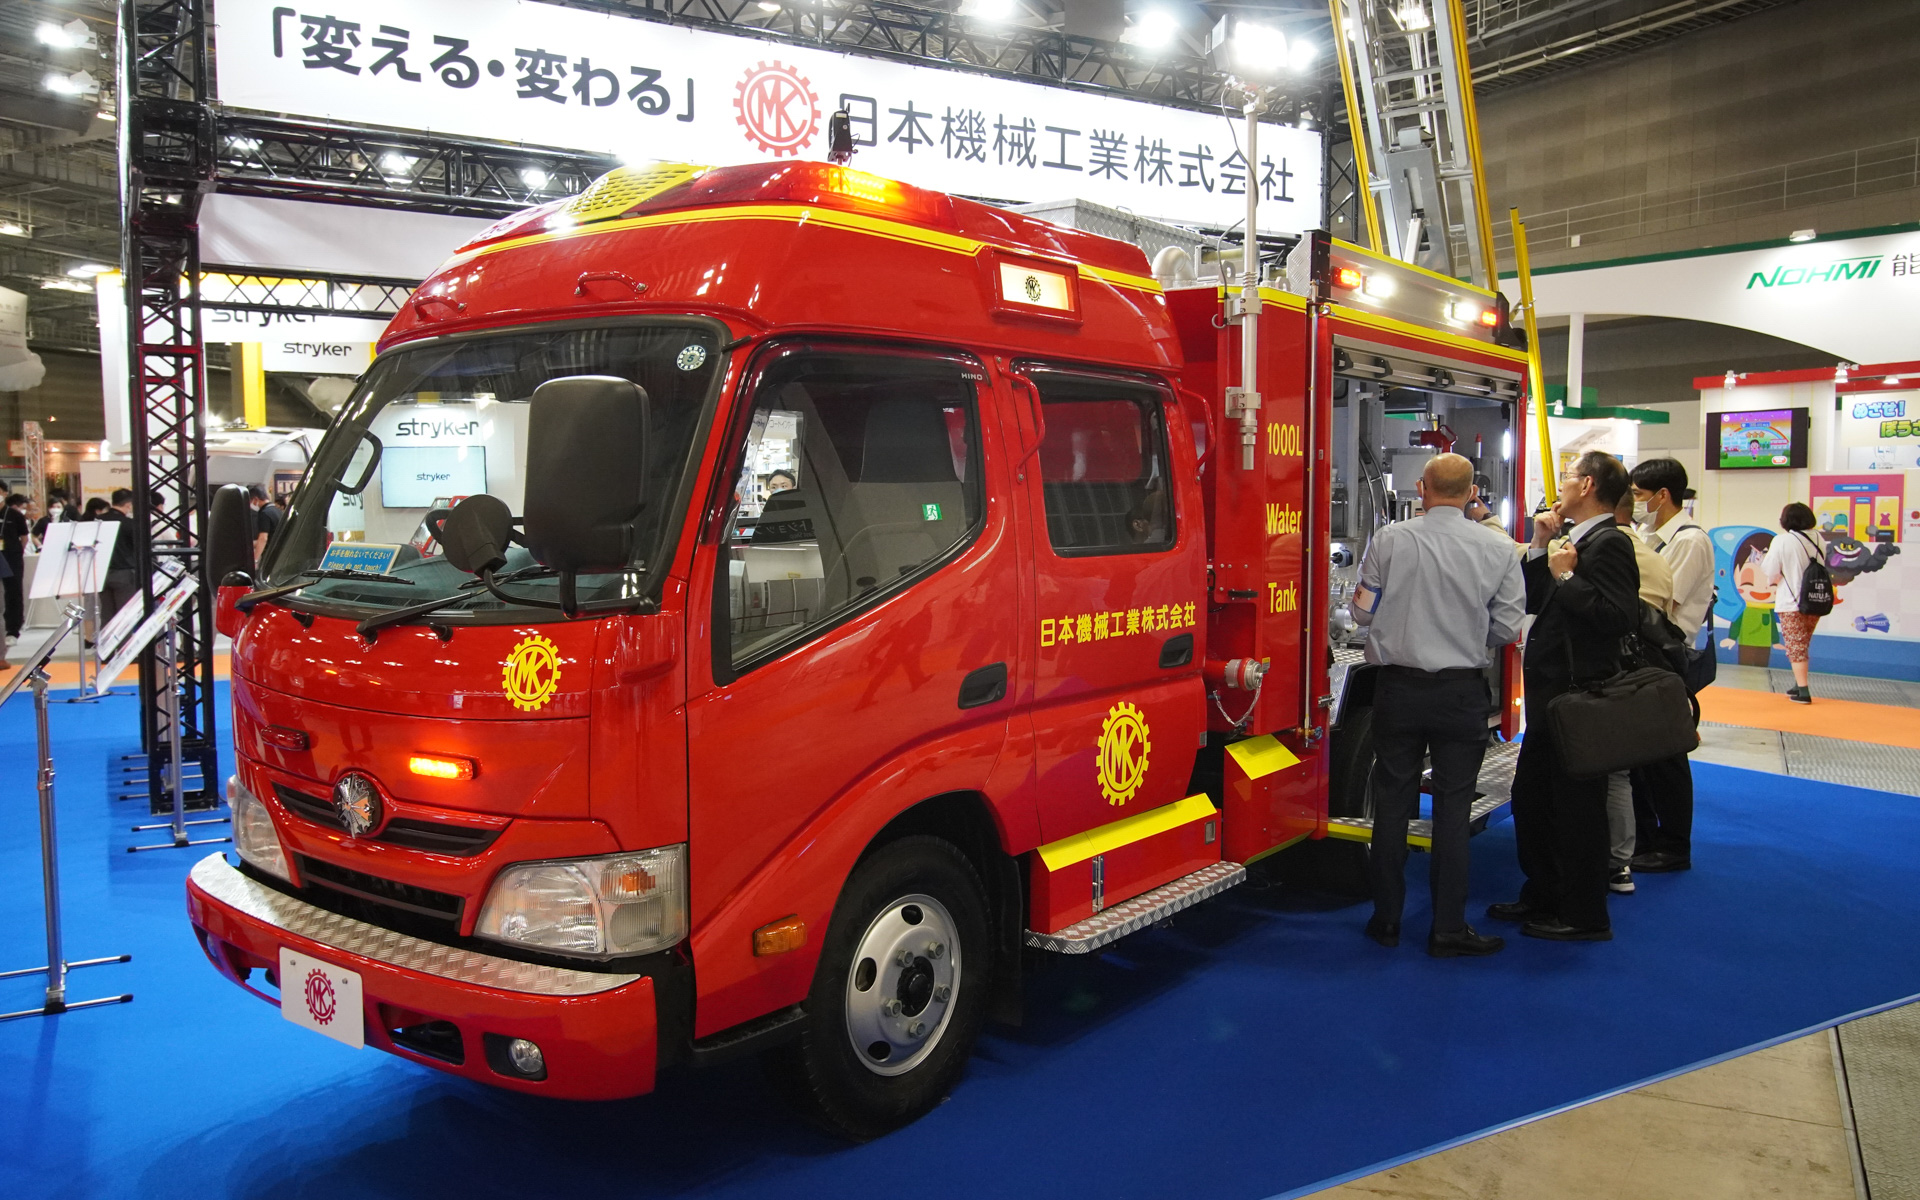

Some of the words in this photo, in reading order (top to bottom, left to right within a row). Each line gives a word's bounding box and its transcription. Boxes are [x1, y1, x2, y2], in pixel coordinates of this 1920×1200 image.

[272, 6, 695, 123] 「変える・変わる」
[839, 93, 1294, 203] 日本機械工業株式会社
[1746, 259, 1882, 289] NOHMI
[283, 342, 352, 357] stryker
[961, 372, 983, 381] HINO
[395, 418, 479, 438] stryker
[1267, 422, 1303, 457] 1000L
[416, 472, 450, 482] stryker
[1266, 503, 1302, 535] Water
[327, 561, 344, 569] Please
[346, 562, 353, 570] do
[1268, 581, 1297, 613] Tank
[1041, 601, 1196, 647] 日本機械工業株式会社
